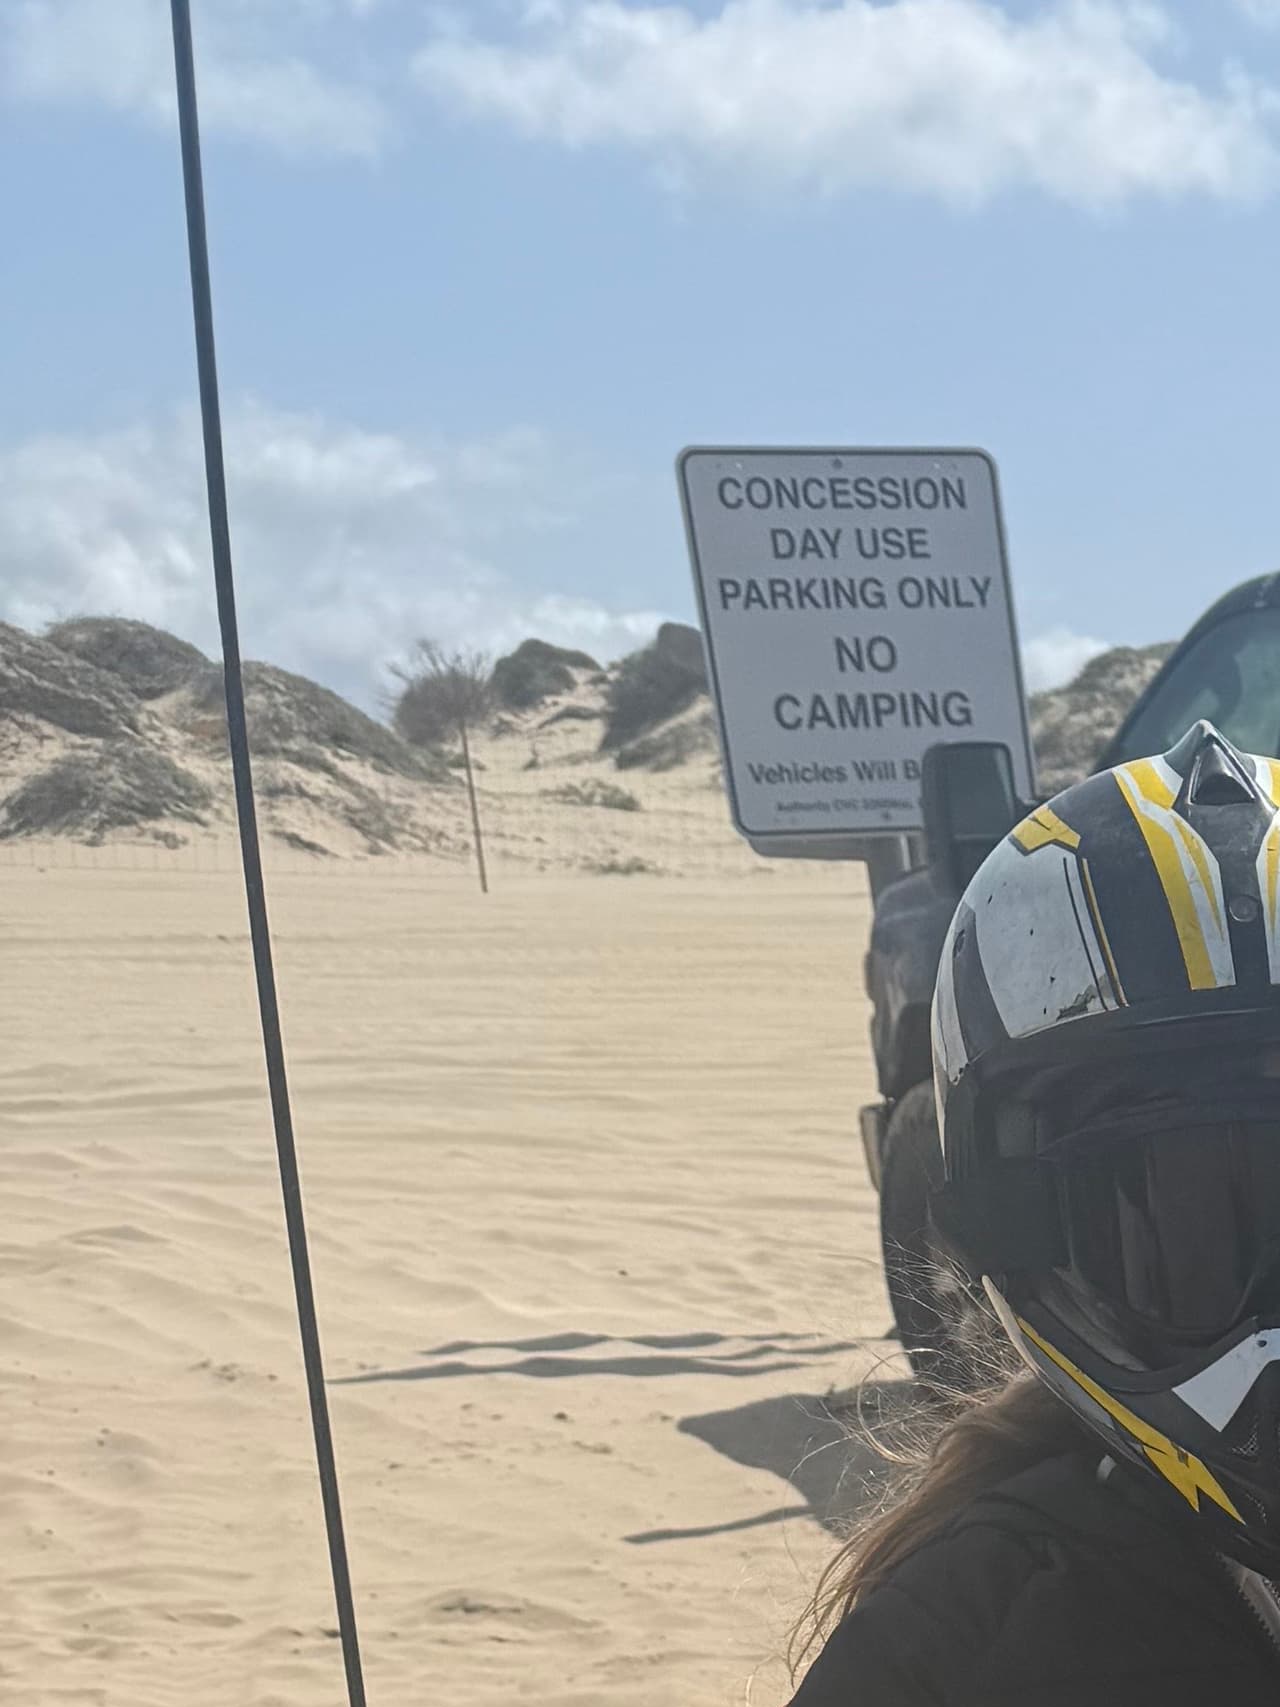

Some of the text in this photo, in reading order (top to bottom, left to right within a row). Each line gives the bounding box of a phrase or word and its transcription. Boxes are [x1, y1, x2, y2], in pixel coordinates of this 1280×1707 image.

[717, 476, 967, 510] CONCESSION
[769, 527, 932, 560] DAY USE
[719, 575, 992, 611] PARKING ONLY
[834, 635, 898, 673] NO
[773, 691, 974, 730] CAMPING
[747, 760, 849, 784] Vehicles
[852, 760, 898, 781] Will
